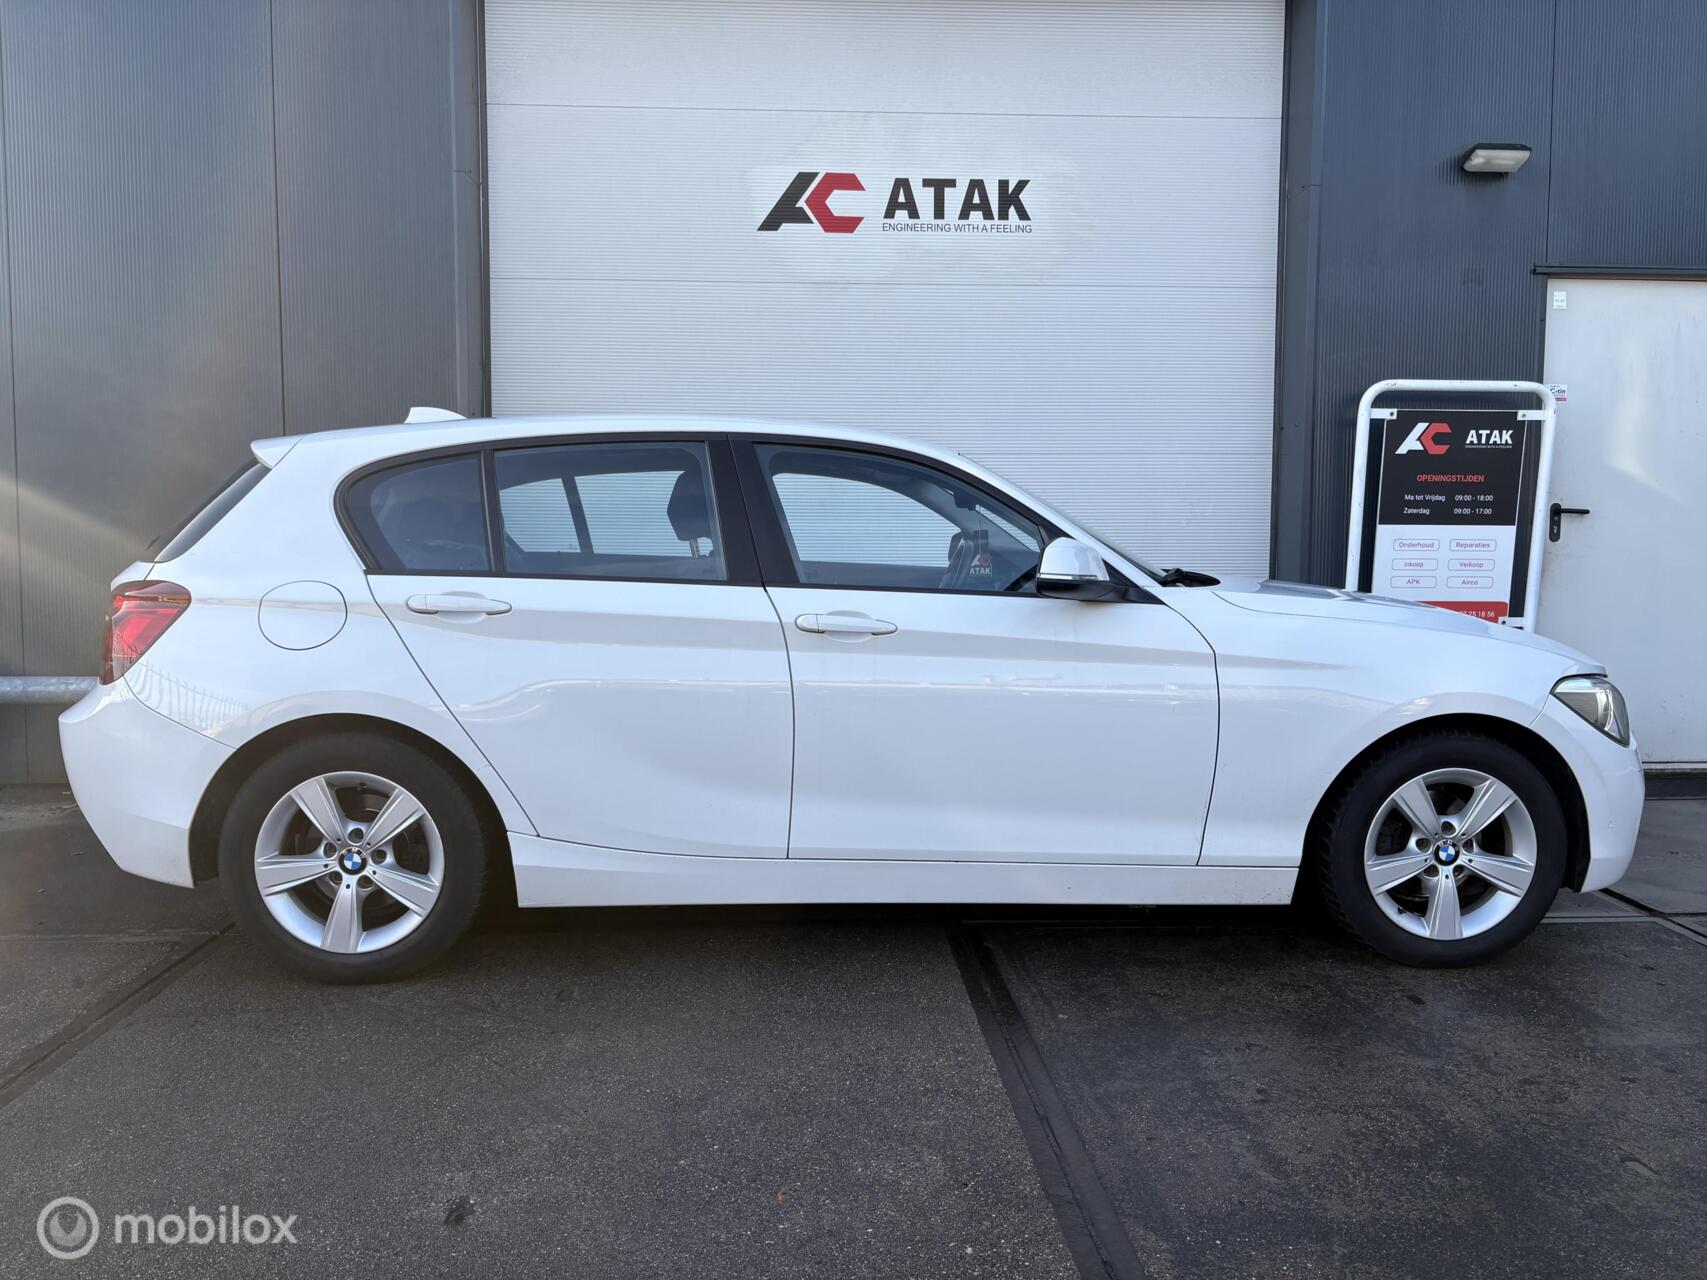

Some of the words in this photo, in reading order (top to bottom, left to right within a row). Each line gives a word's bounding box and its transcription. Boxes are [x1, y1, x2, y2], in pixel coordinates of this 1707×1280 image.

[883, 177, 1032, 221] ATAK
[882, 222, 952, 233] ENGINEERING
[953, 223, 980, 233] WITH
[980, 224, 988, 233] A
[990, 224, 1033, 234] FEELING
[1465, 429, 1514, 444] ATAK
[1416, 474, 1485, 482] OPENINGSTIJDEN
[1425, 494, 1446, 502] Vrijdag
[969, 567, 991, 576] ATAK
